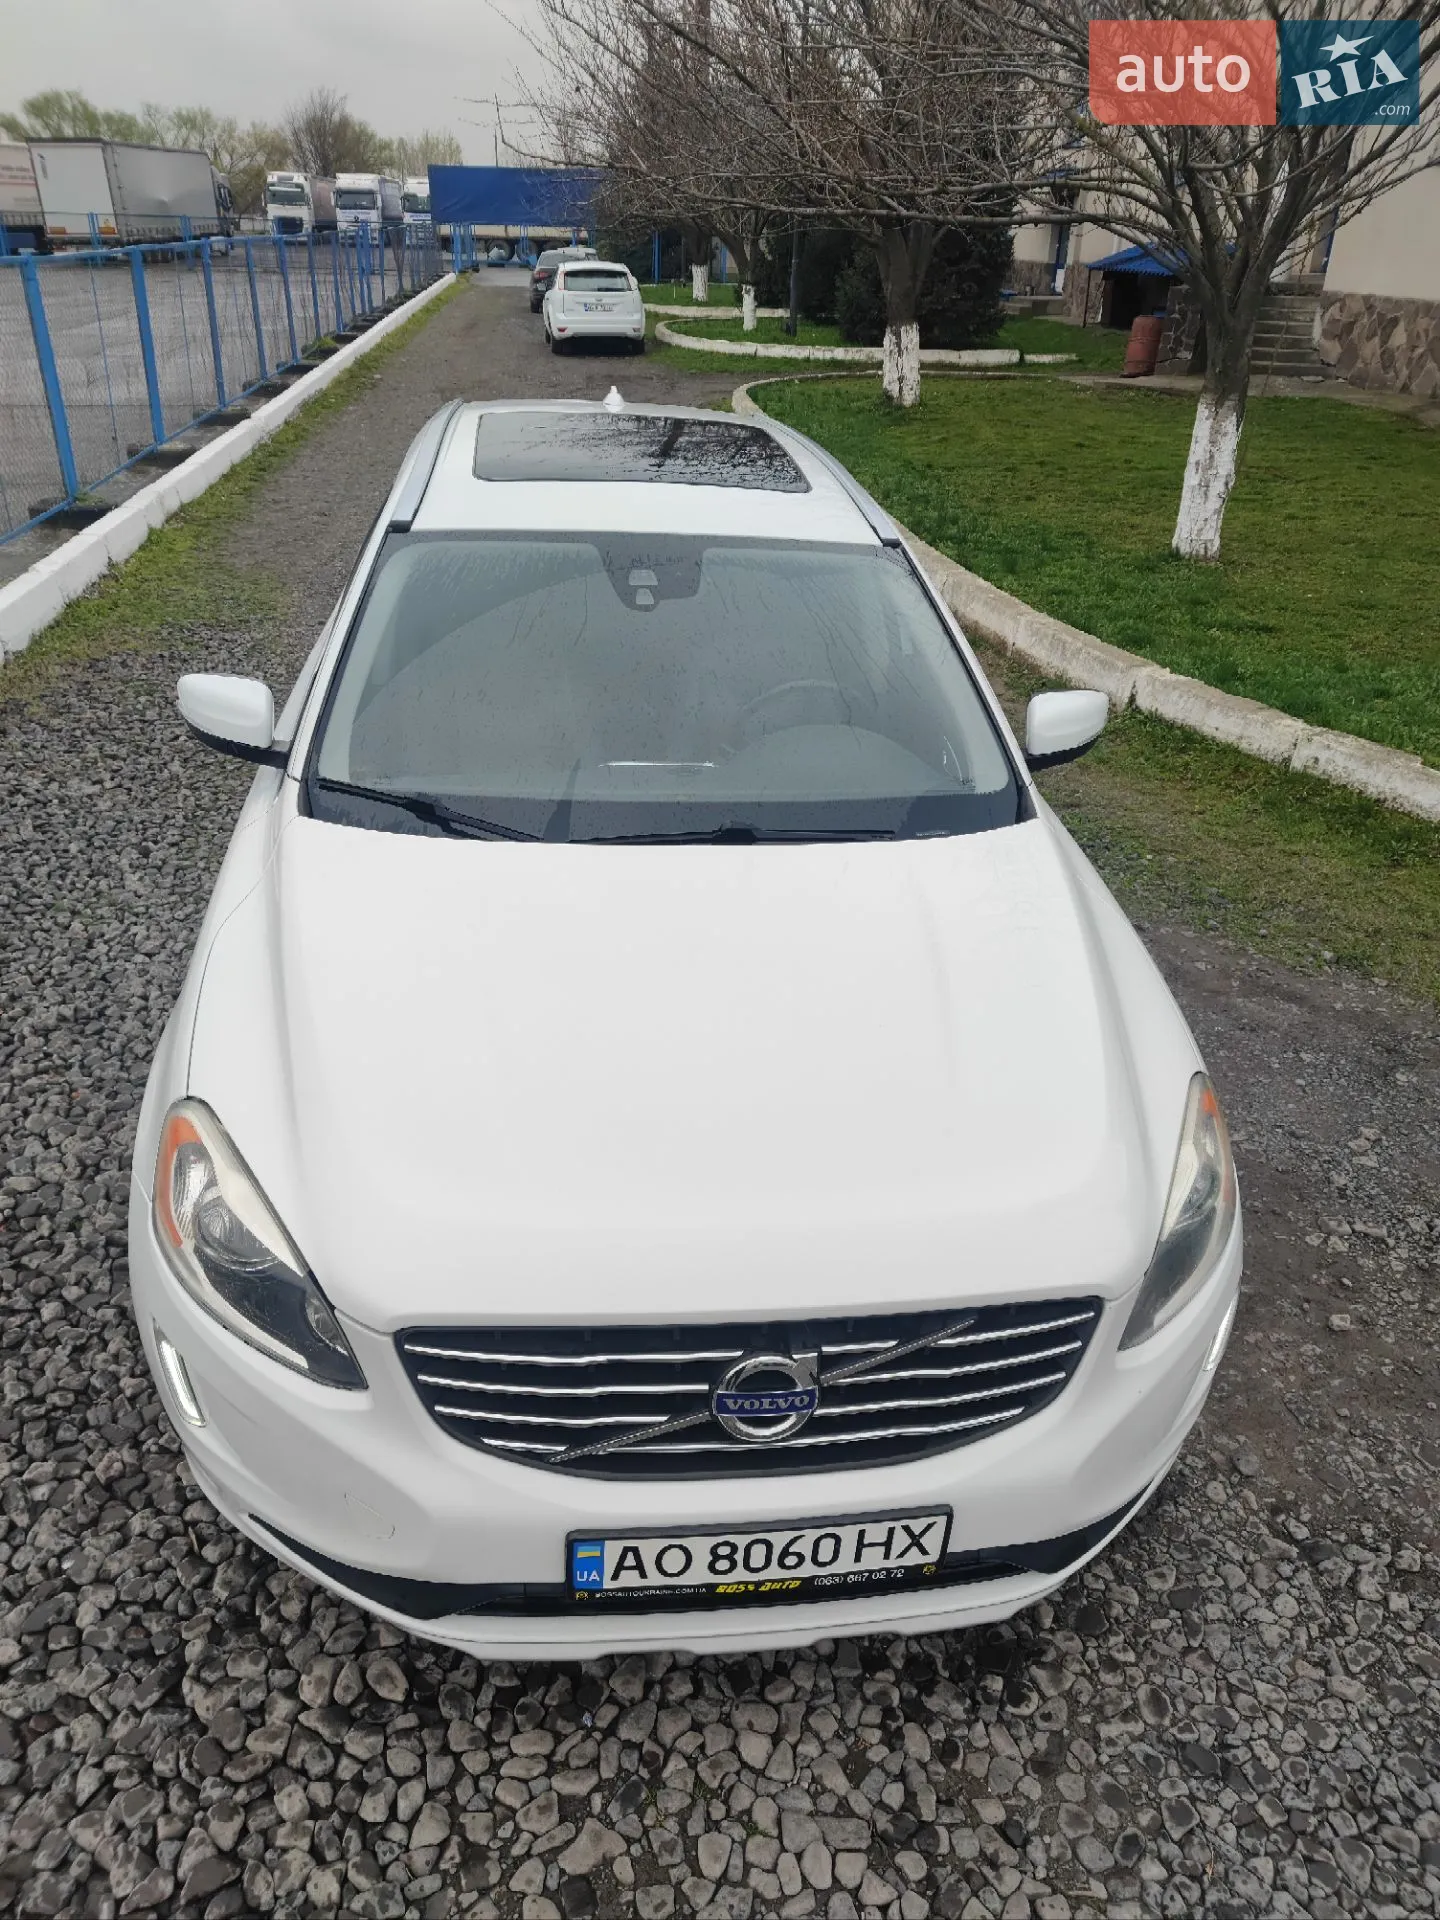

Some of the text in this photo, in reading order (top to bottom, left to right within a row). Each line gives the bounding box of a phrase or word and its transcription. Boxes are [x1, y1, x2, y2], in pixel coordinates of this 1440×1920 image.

[723, 1395, 810, 1410] VOLVO
[610, 1521, 938, 1581] AO 8060 HX
[577, 1571, 600, 1582] UA
[890, 1568, 905, 1578] 72
